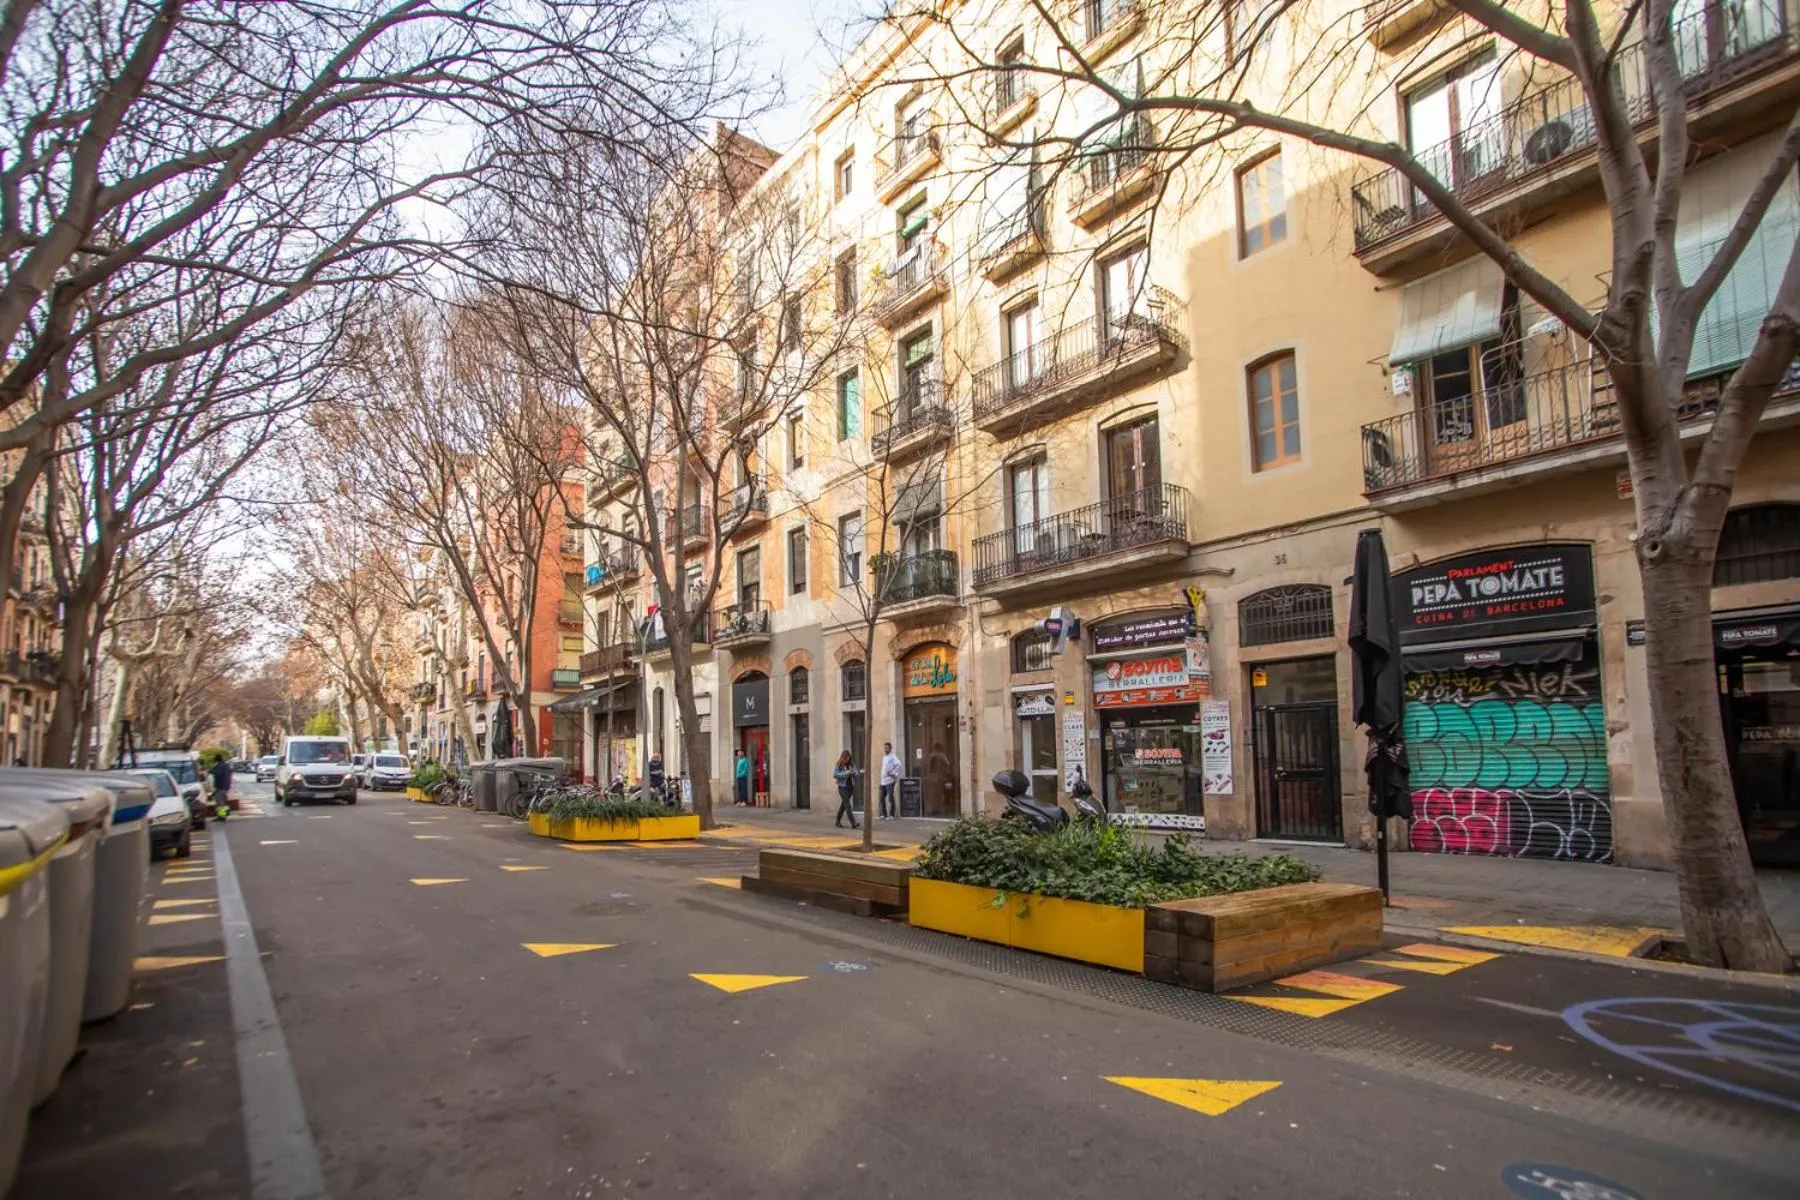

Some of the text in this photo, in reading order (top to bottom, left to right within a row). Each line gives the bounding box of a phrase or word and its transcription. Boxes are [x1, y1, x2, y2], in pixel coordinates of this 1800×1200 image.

[1448, 560, 1514, 580] PARLAMENT
[1411, 565, 1564, 606] PEPA TOMATE
[1415, 597, 1565, 625] CUINA DE BARCELONA
[1743, 627, 1777, 638] TOMATE
[1108, 675, 1185, 688] SERRALLERIA
[745, 696, 755, 710] M
